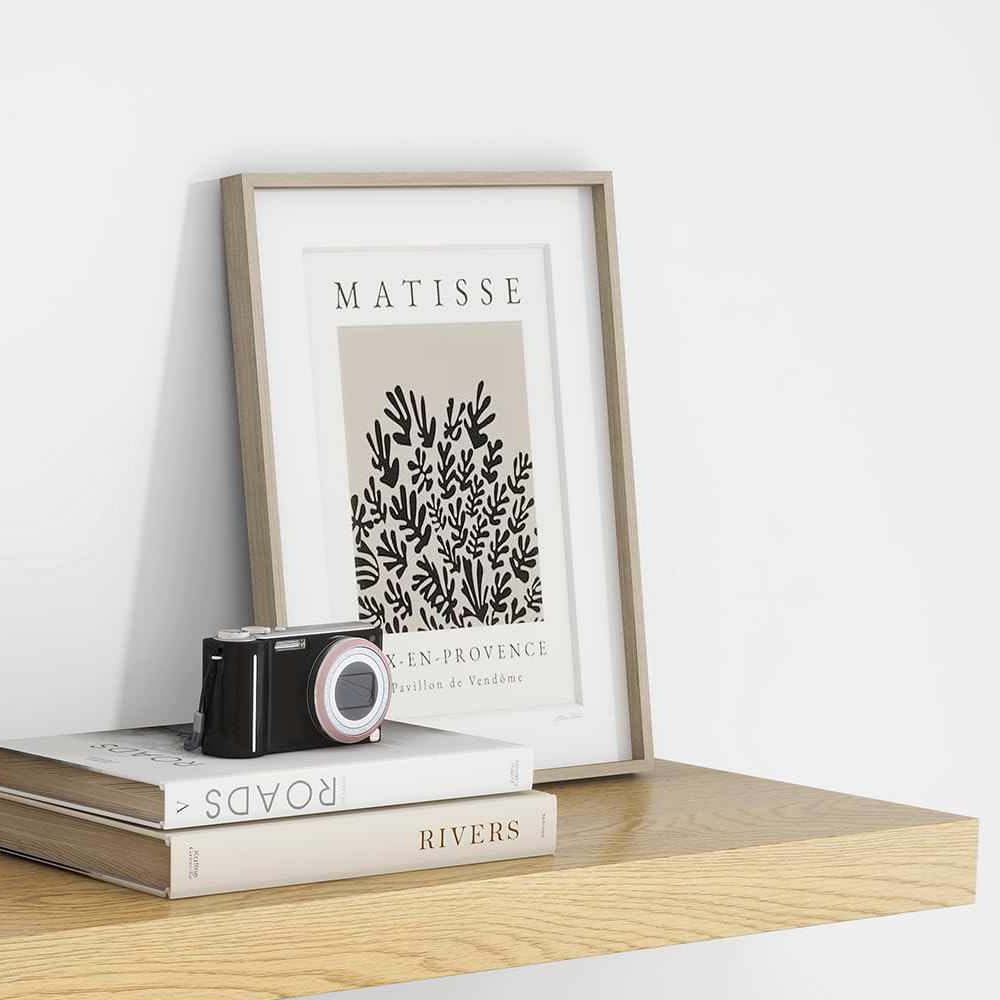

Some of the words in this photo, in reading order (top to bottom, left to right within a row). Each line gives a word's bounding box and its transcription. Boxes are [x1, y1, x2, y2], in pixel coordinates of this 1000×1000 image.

[334, 277, 521, 310] MATISSE
[387, 641, 548, 668] X-EN-PROVENCE
[391, 682, 443, 693] Pavillon
[450, 678, 462, 688] de
[468, 674, 524, 687] Vendôme
[205, 776, 337, 820] ROADS
[419, 819, 521, 850] RIVERS
